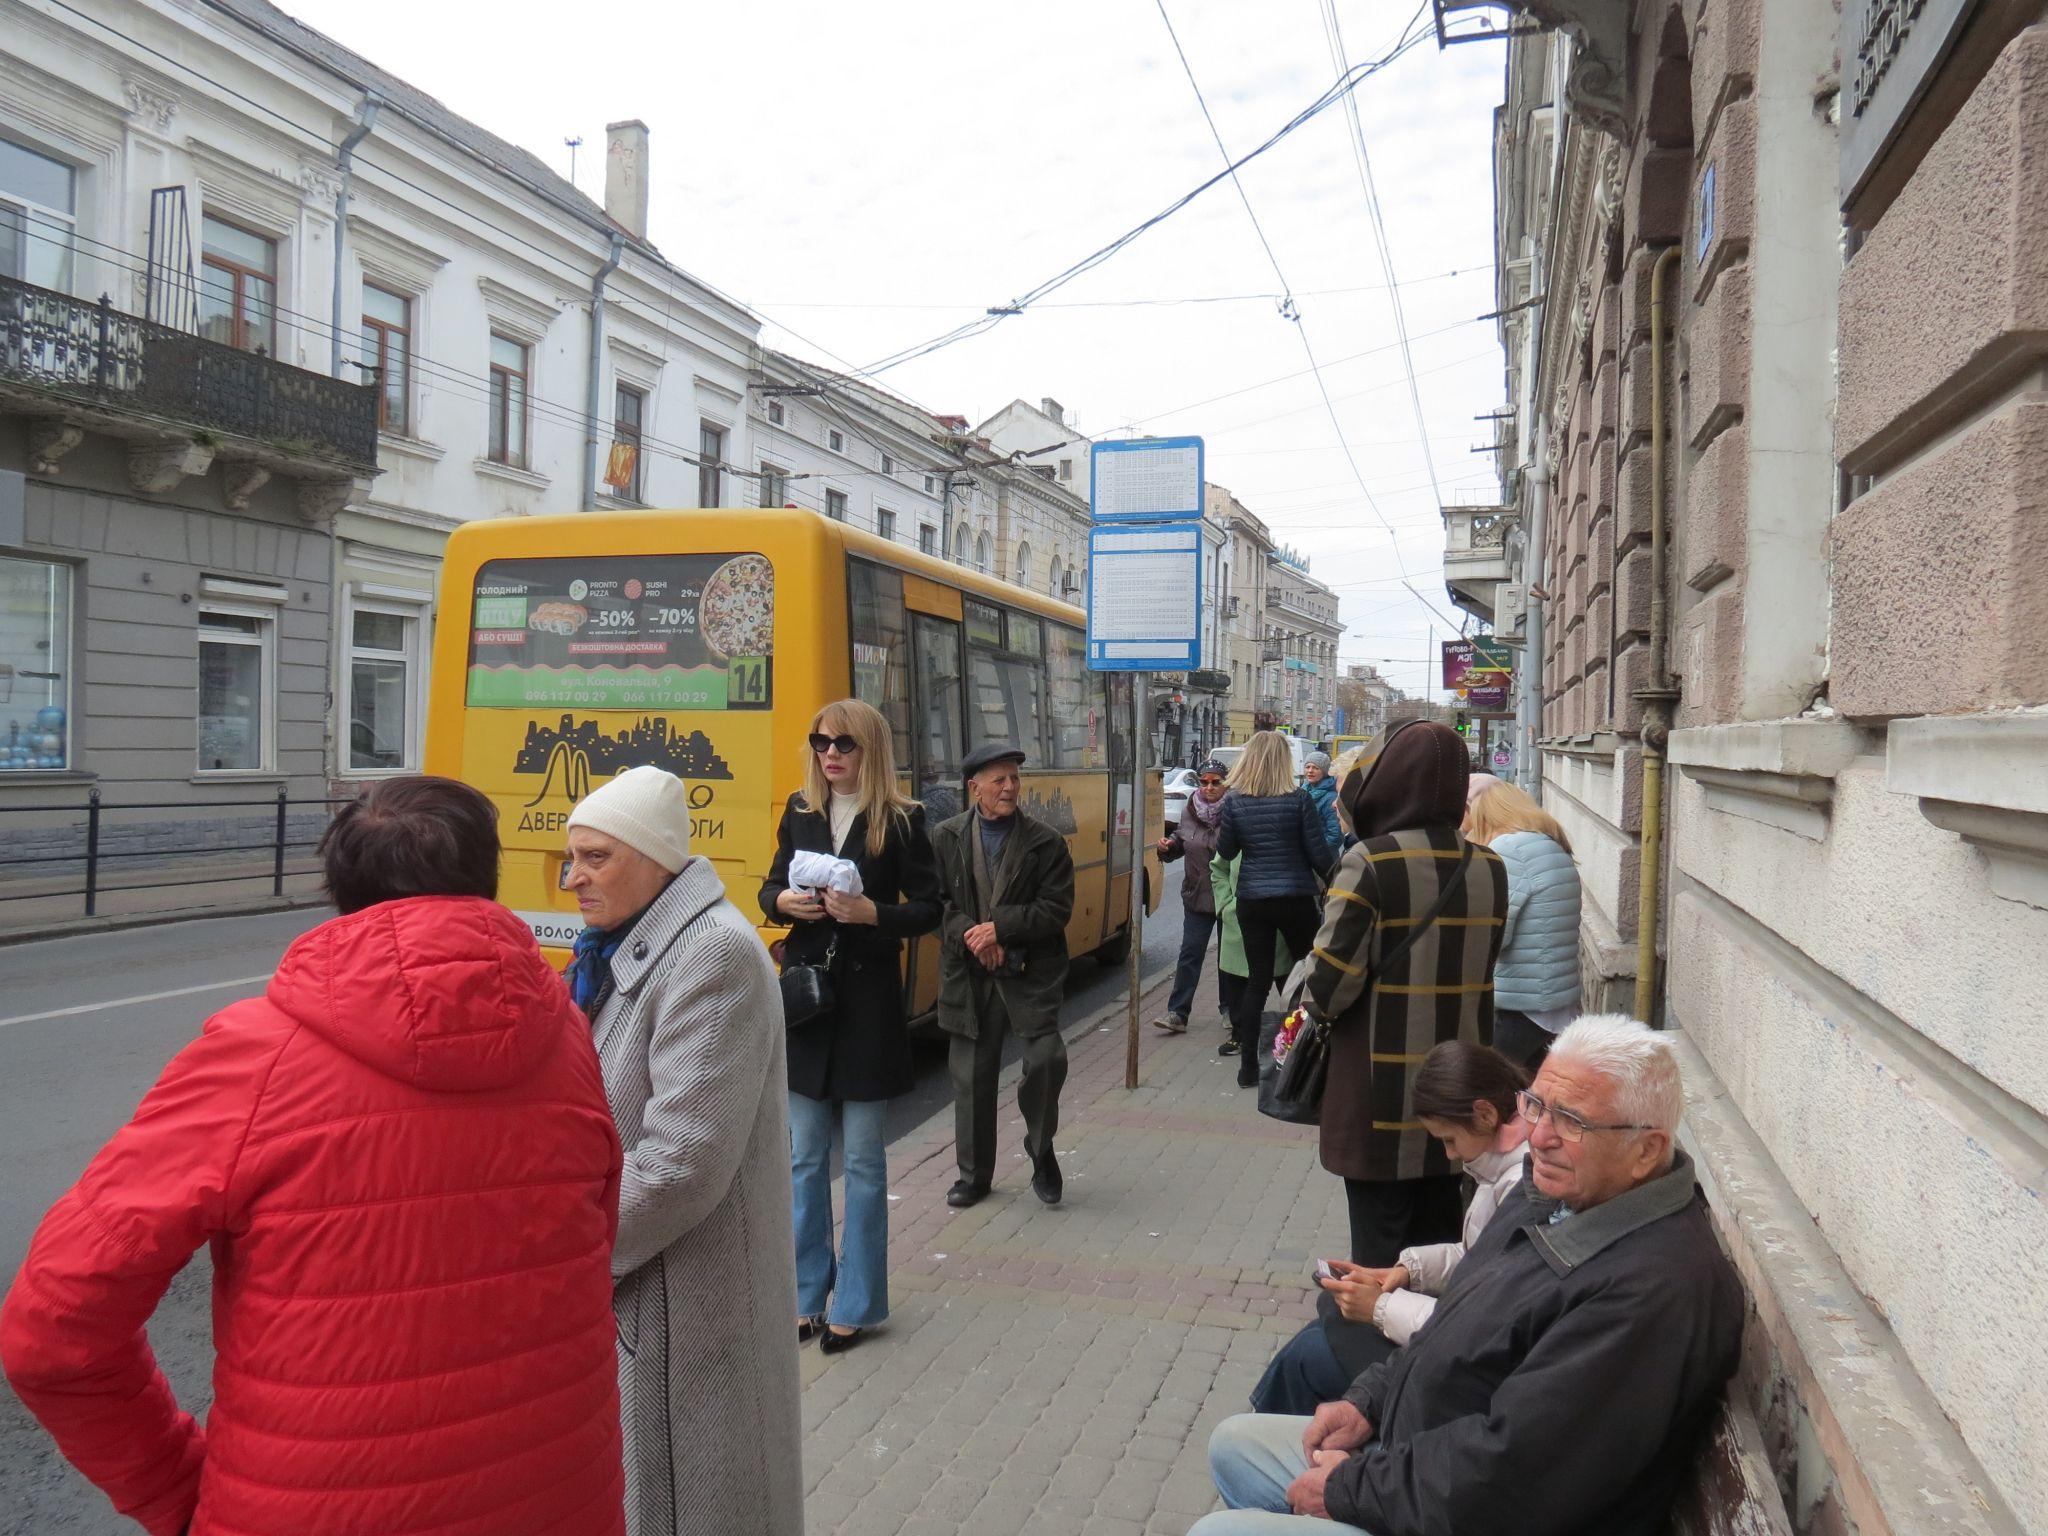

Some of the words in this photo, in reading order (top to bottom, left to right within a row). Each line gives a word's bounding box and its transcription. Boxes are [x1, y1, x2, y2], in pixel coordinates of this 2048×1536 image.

[589, 581, 618, 589] PRONTO
[645, 581, 668, 589] SUSHI
[478, 633, 495, 642] АБО
[625, 644, 664, 652] ДОСТАВКА
[560, 677, 584, 688] вул.
[663, 676, 672, 685] 9
[735, 664, 762, 702] 14
[525, 691, 547, 702] 096
[550, 691, 571, 702] 117
[574, 691, 589, 702] 00
[592, 692, 607, 702] 29
[623, 691, 646, 702] 066
[650, 691, 671, 702] 117
[675, 692, 690, 703] 00
[693, 692, 708, 703] 29
